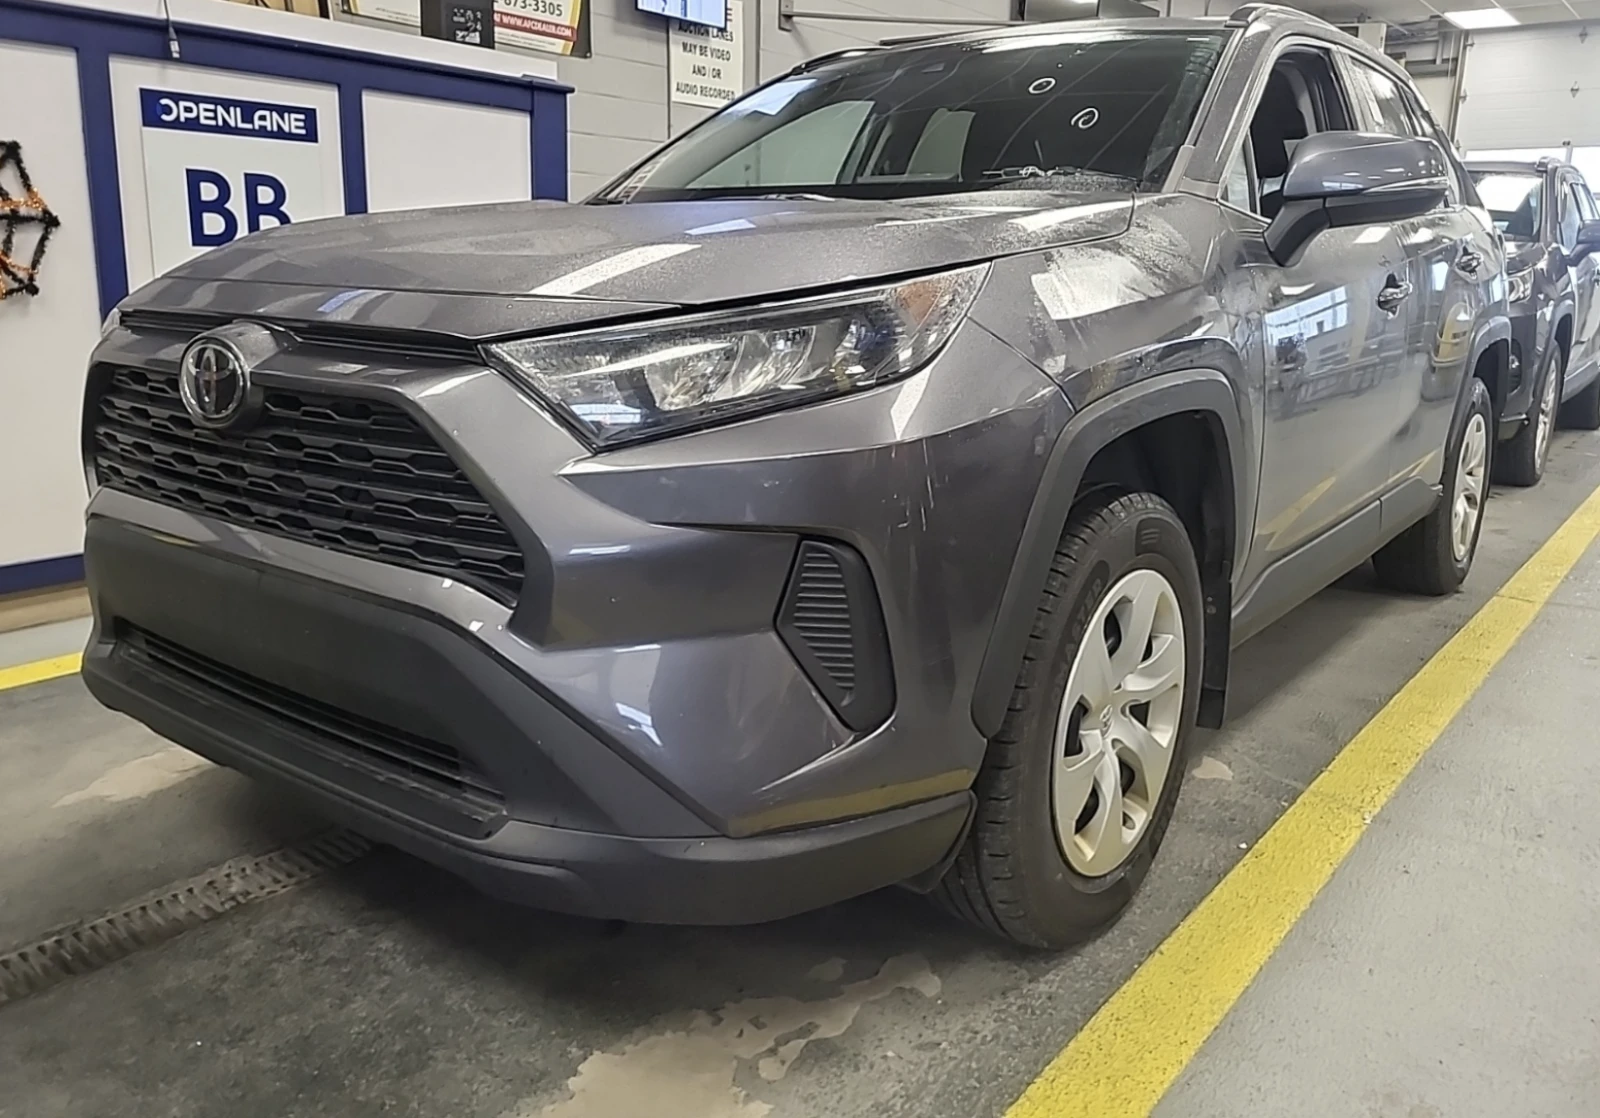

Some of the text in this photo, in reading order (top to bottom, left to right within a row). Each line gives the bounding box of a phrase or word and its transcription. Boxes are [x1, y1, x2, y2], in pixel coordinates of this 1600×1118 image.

[682, 41, 731, 62] MAY BE VIDEO
[692, 64, 706, 77] AND
[712, 67, 722, 79] OR
[676, 81, 735, 101] AUDIO RECORDED
[156, 98, 307, 135] OPENLANE
[186, 168, 292, 247] BB
